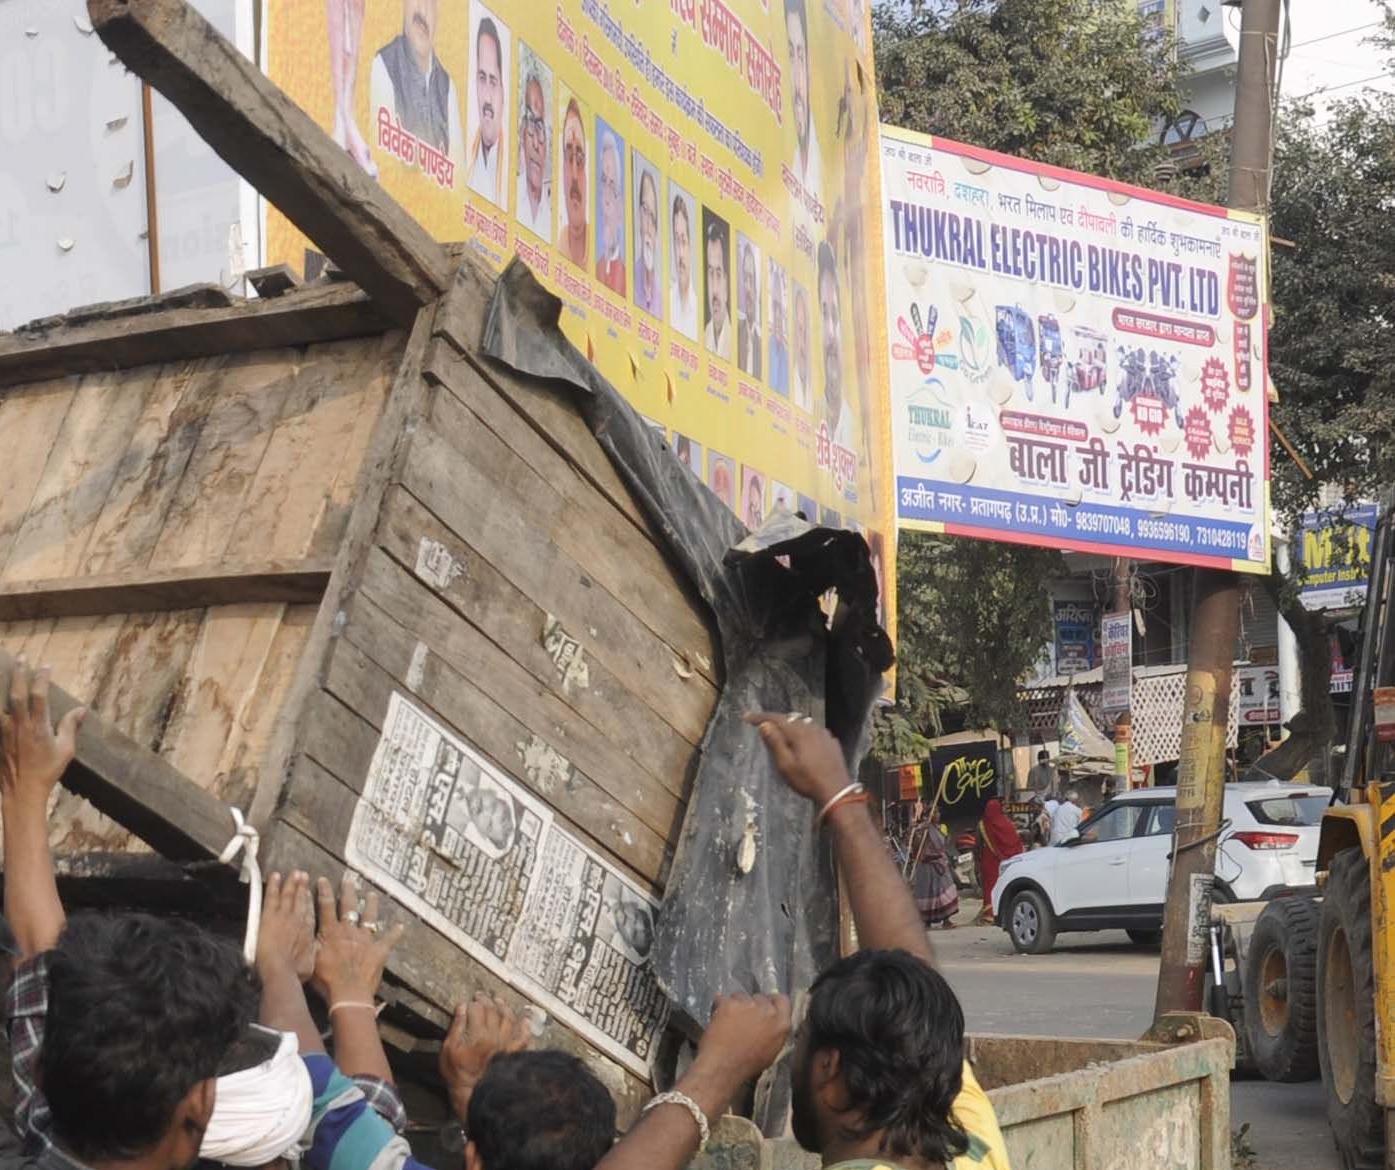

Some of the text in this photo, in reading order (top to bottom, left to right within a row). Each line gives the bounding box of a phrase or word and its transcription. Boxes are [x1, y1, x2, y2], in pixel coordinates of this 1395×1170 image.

[378, 106, 455, 189] विवेक पाण्डेय
[998, 192, 1021, 216] भरत
[1025, 193, 1056, 222] मिलाप
[1077, 205, 1117, 237] दीपावली
[1119, 216, 1133, 239] की
[1137, 221, 1167, 246] हार्दिक
[890, 200, 986, 269] THUKRAL
[990, 223, 1082, 288] ELECTRIC
[1087, 244, 1143, 301] BIKES
[1148, 258, 1185, 309] PVT.
[1189, 266, 1219, 316] LTD
[908, 405, 951, 429] THUKRAL
[1006, 436, 1254, 508] बाला जी ट्रेडिंग कम्पनी
[901, 482, 935, 510] अजीत
[1197, 526, 1246, 550] 7310428119
